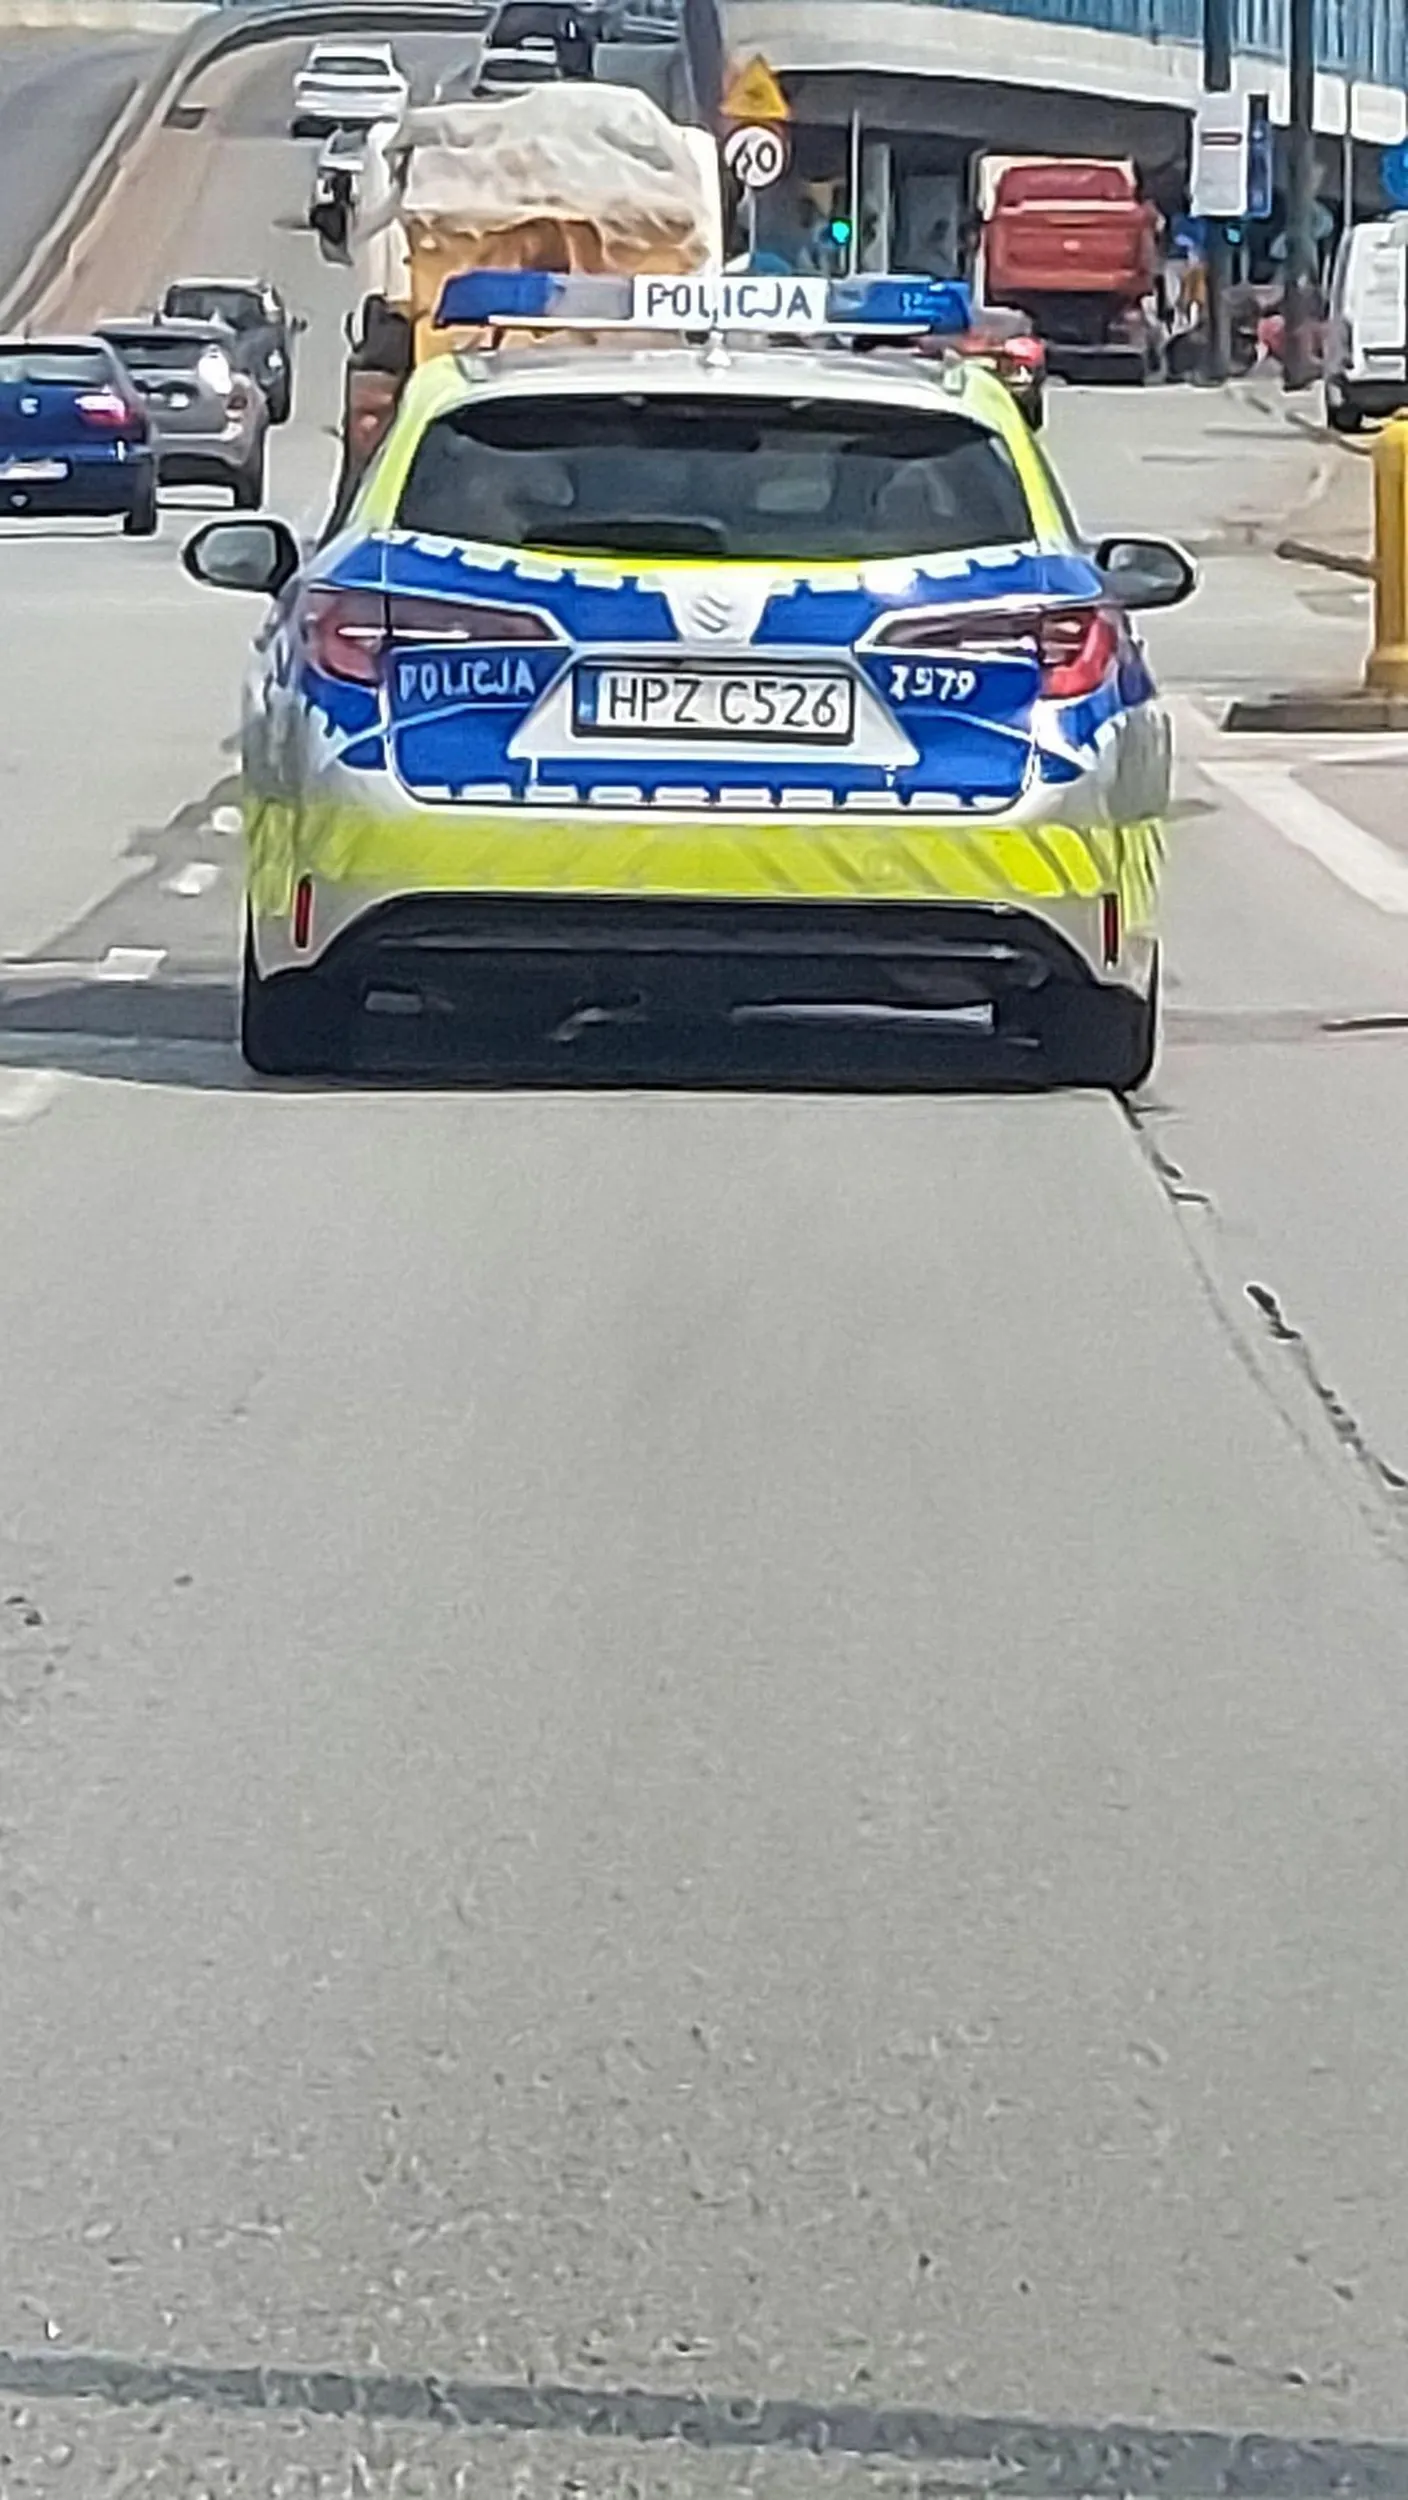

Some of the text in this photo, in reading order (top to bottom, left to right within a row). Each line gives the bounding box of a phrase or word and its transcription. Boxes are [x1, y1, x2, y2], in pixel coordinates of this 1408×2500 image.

[647, 282, 812, 319] POLICJA
[398, 657, 536, 701] POLICJA
[609, 676, 838, 728] HPZ C526
